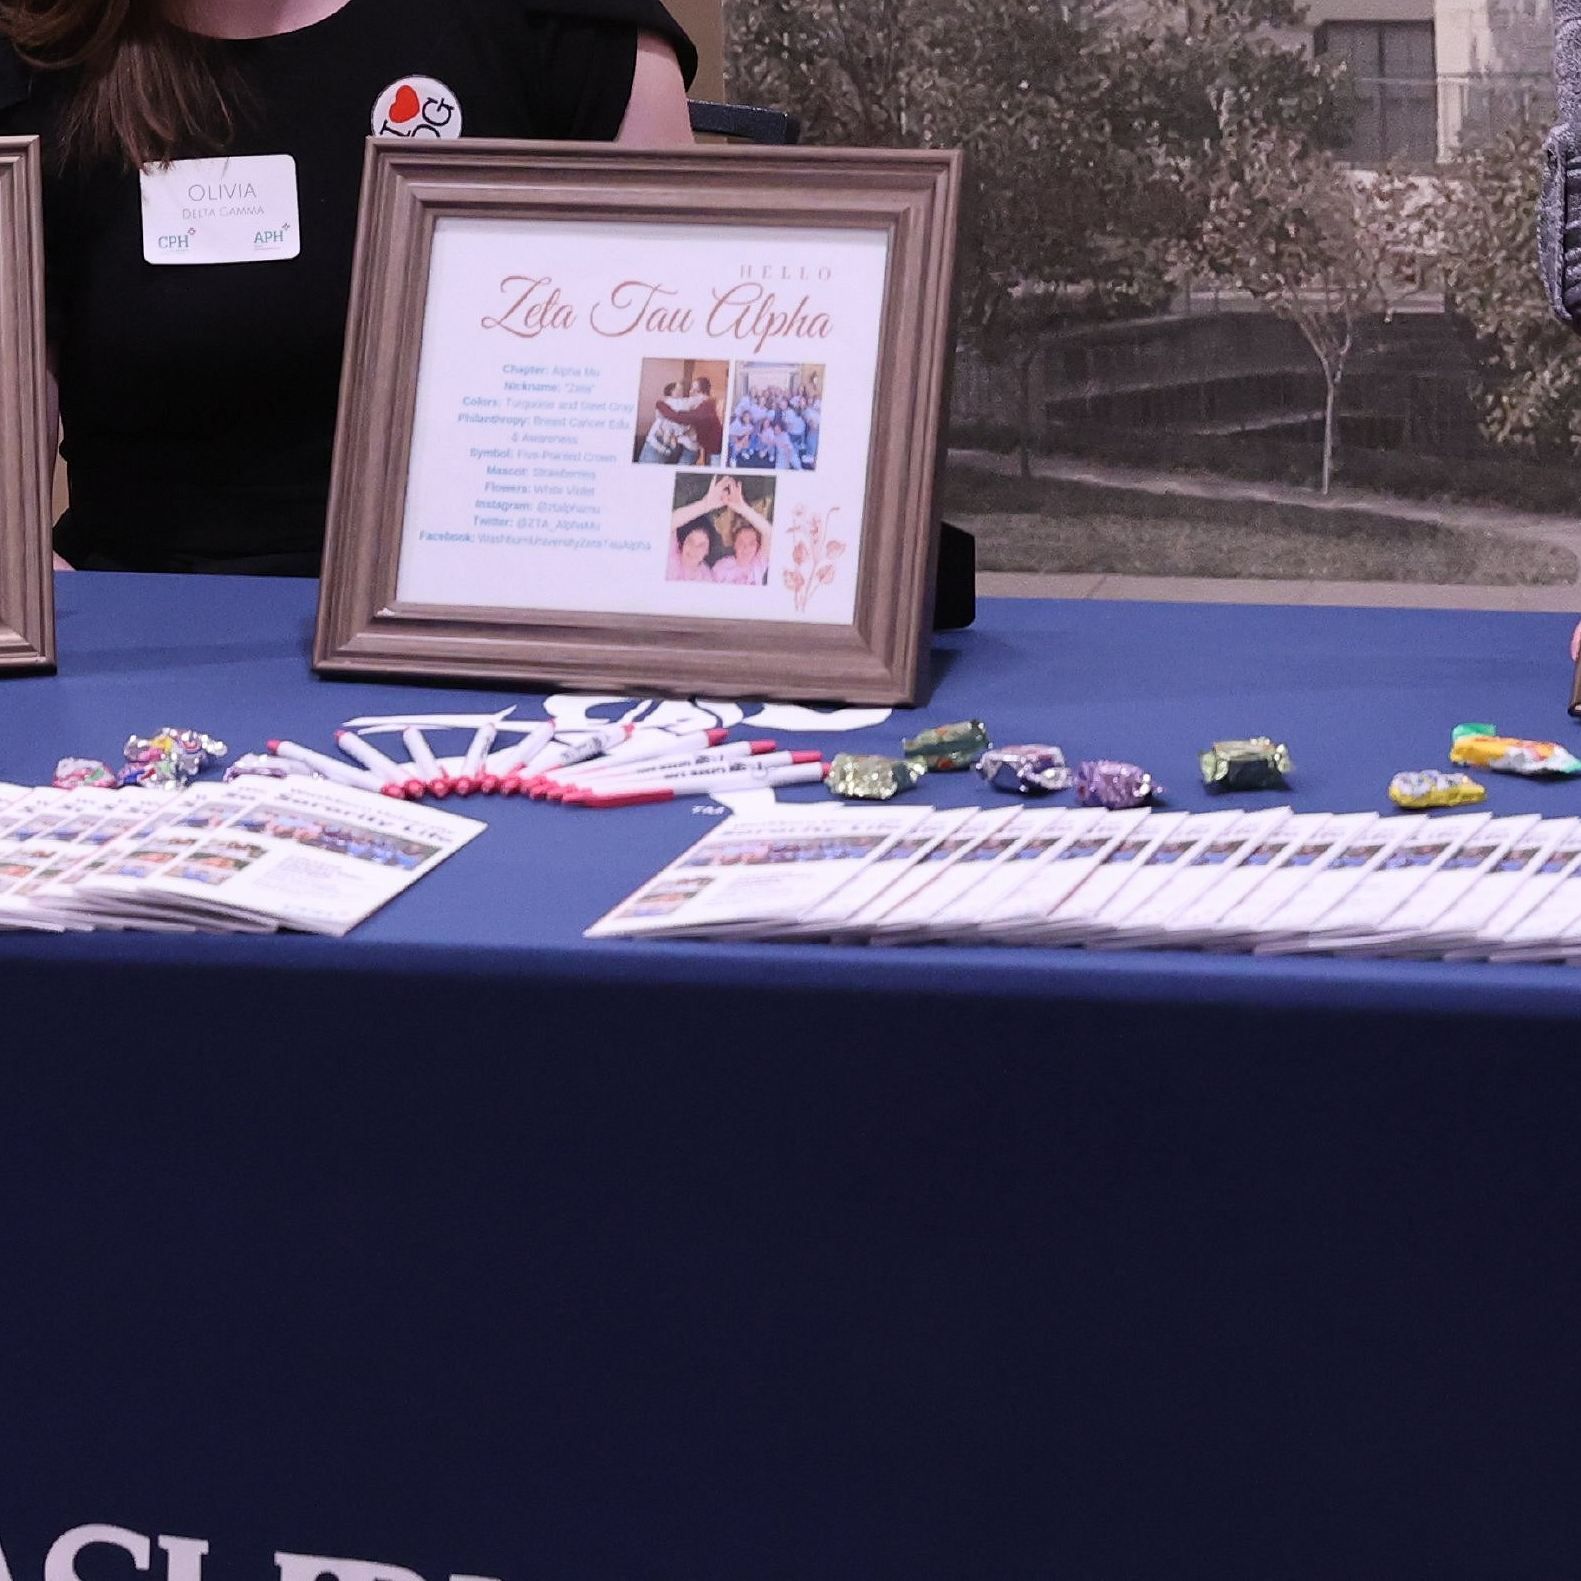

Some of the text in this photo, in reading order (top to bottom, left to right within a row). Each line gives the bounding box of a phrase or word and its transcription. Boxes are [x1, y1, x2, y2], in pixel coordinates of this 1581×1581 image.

[188, 182, 257, 202] OLIVIA
[158, 234, 190, 250] CPH
[254, 230, 284, 245] APH
[739, 264, 833, 282] HELLO
[480, 274, 834, 354] Zeta Tau Alpha
